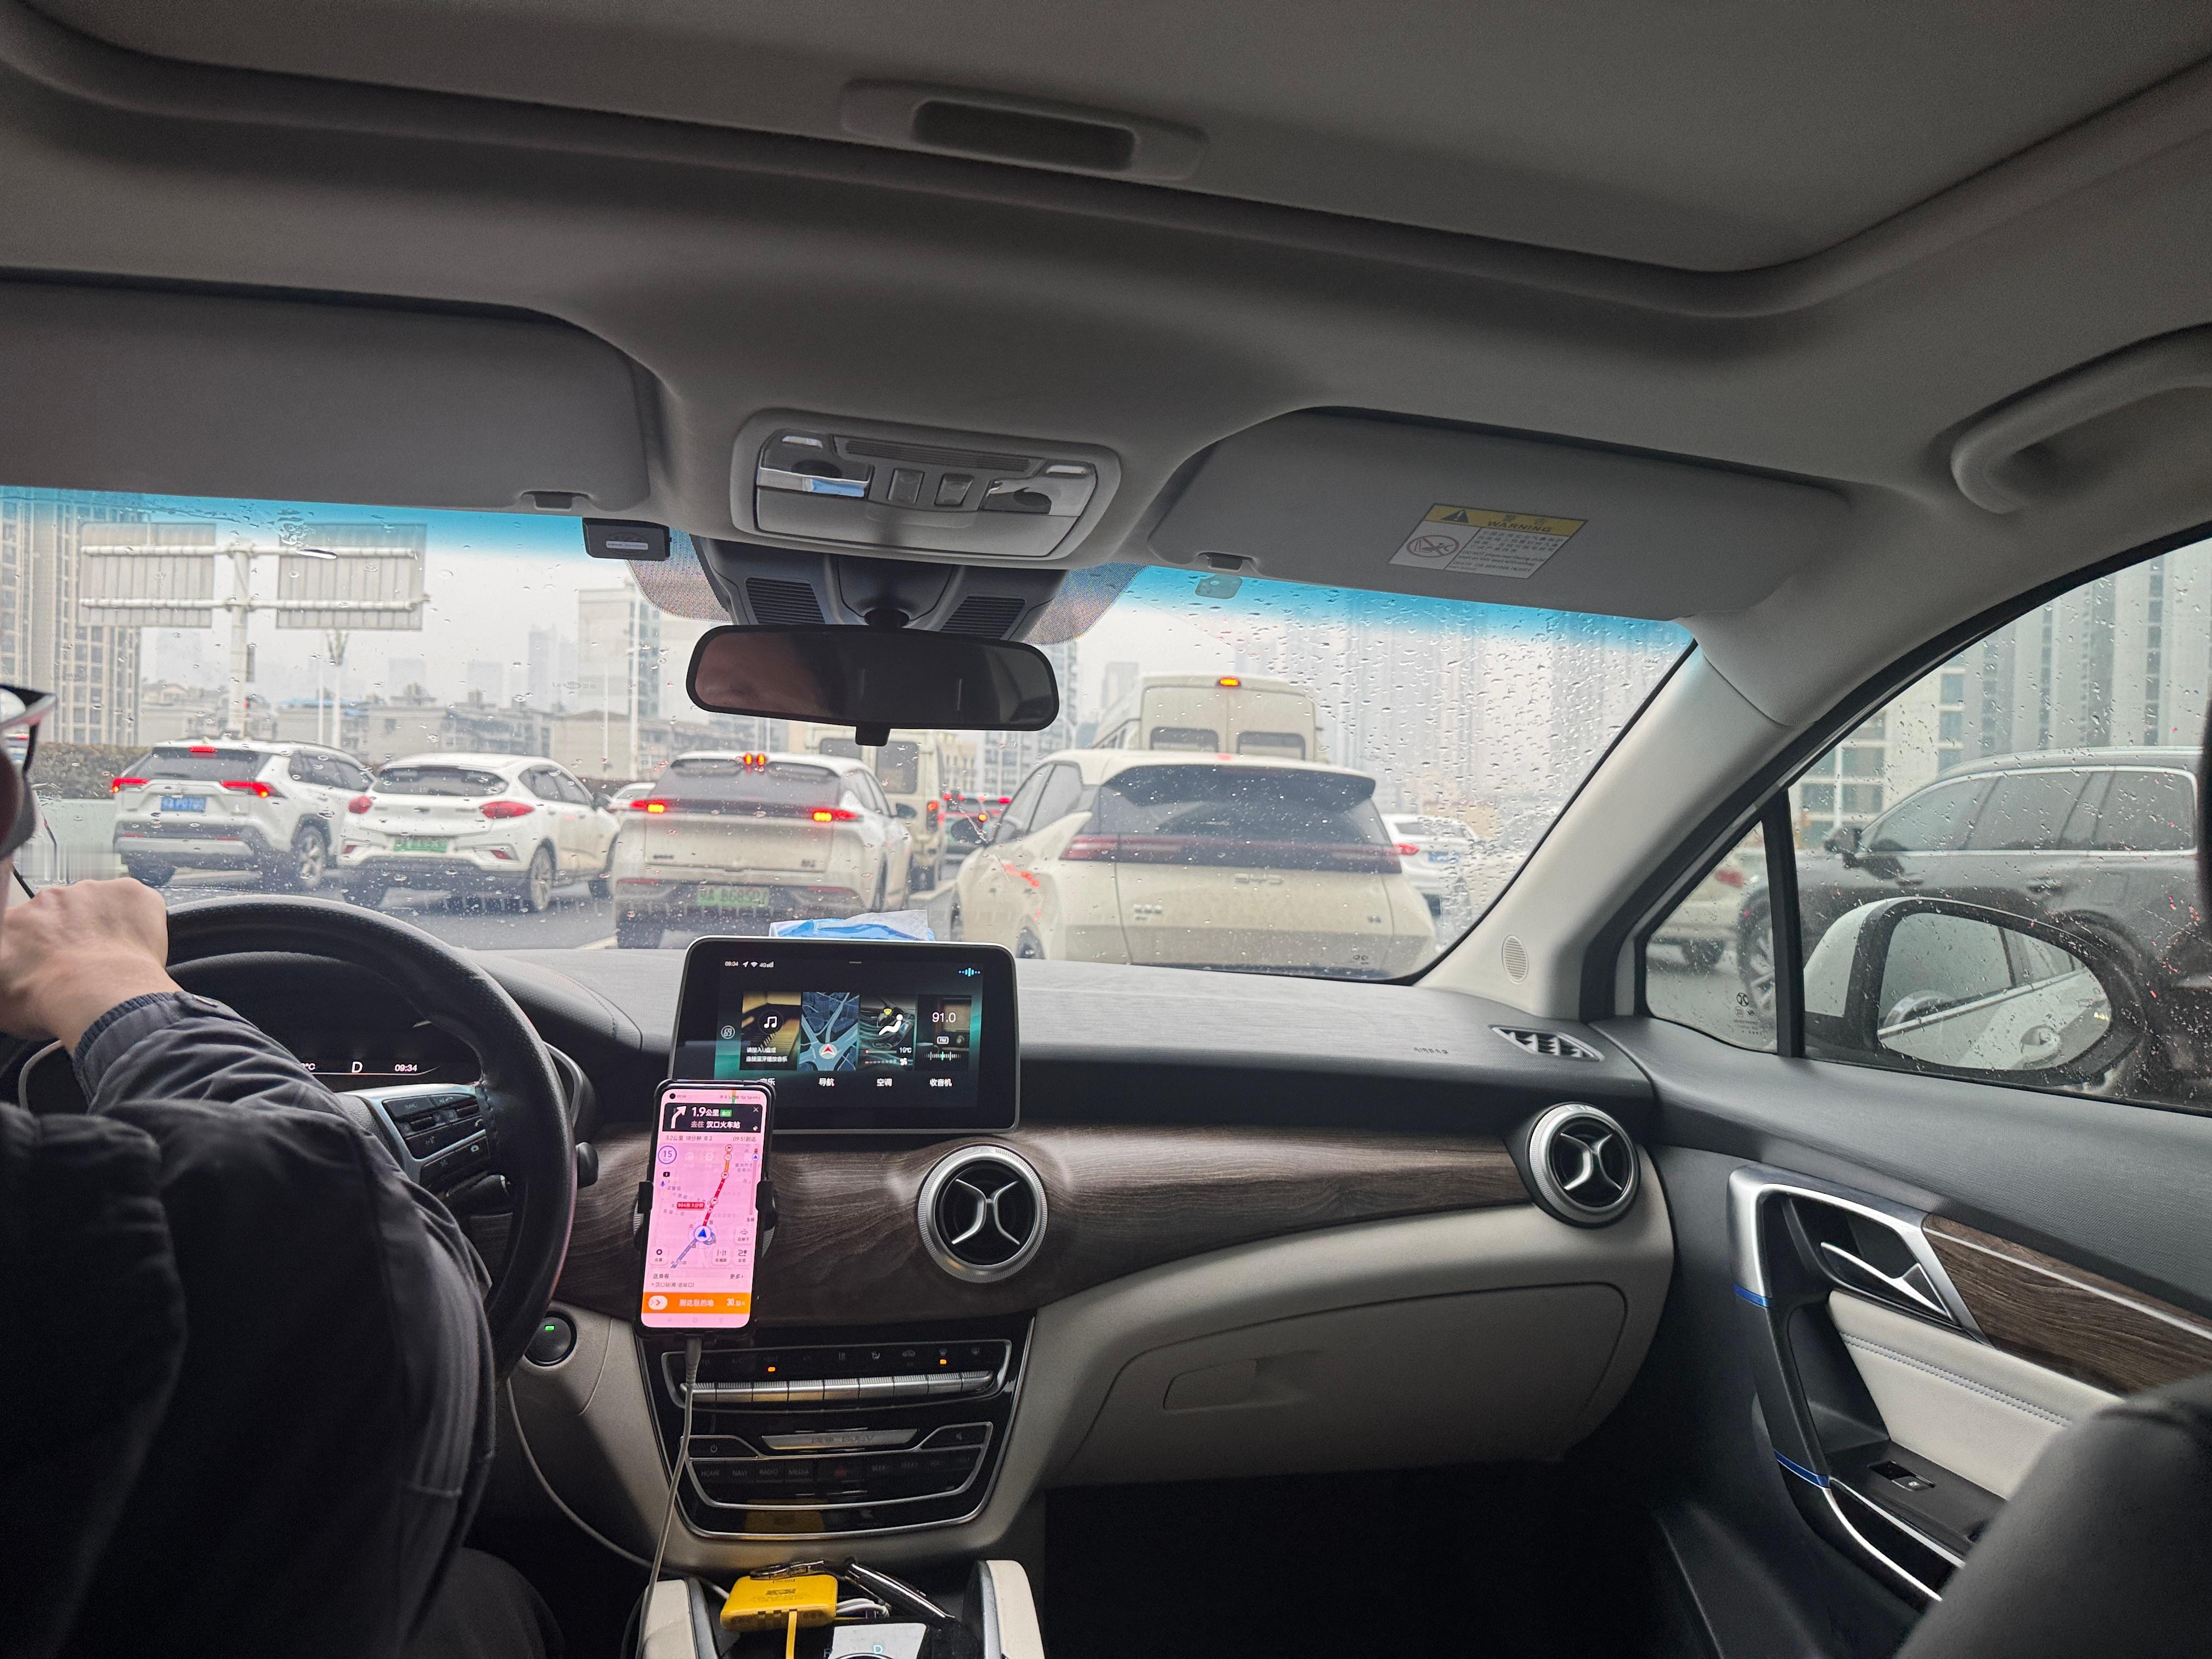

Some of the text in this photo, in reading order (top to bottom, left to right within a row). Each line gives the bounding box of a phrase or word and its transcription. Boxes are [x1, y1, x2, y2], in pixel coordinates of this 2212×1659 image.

[1487, 521, 1551, 532] WARNING
[932, 1011, 957, 1024] 91.0
[351, 1061, 363, 1074] D
[394, 1063, 418, 1072] 09:34
[818, 1077, 835, 1087] 导航
[876, 1077, 893, 1087] 空调
[929, 1077, 952, 1087] 收音机
[691, 1107, 720, 1117] 1.9公里
[706, 1121, 741, 1129] 汉口火车站
[873, 1644, 884, 1655] D
